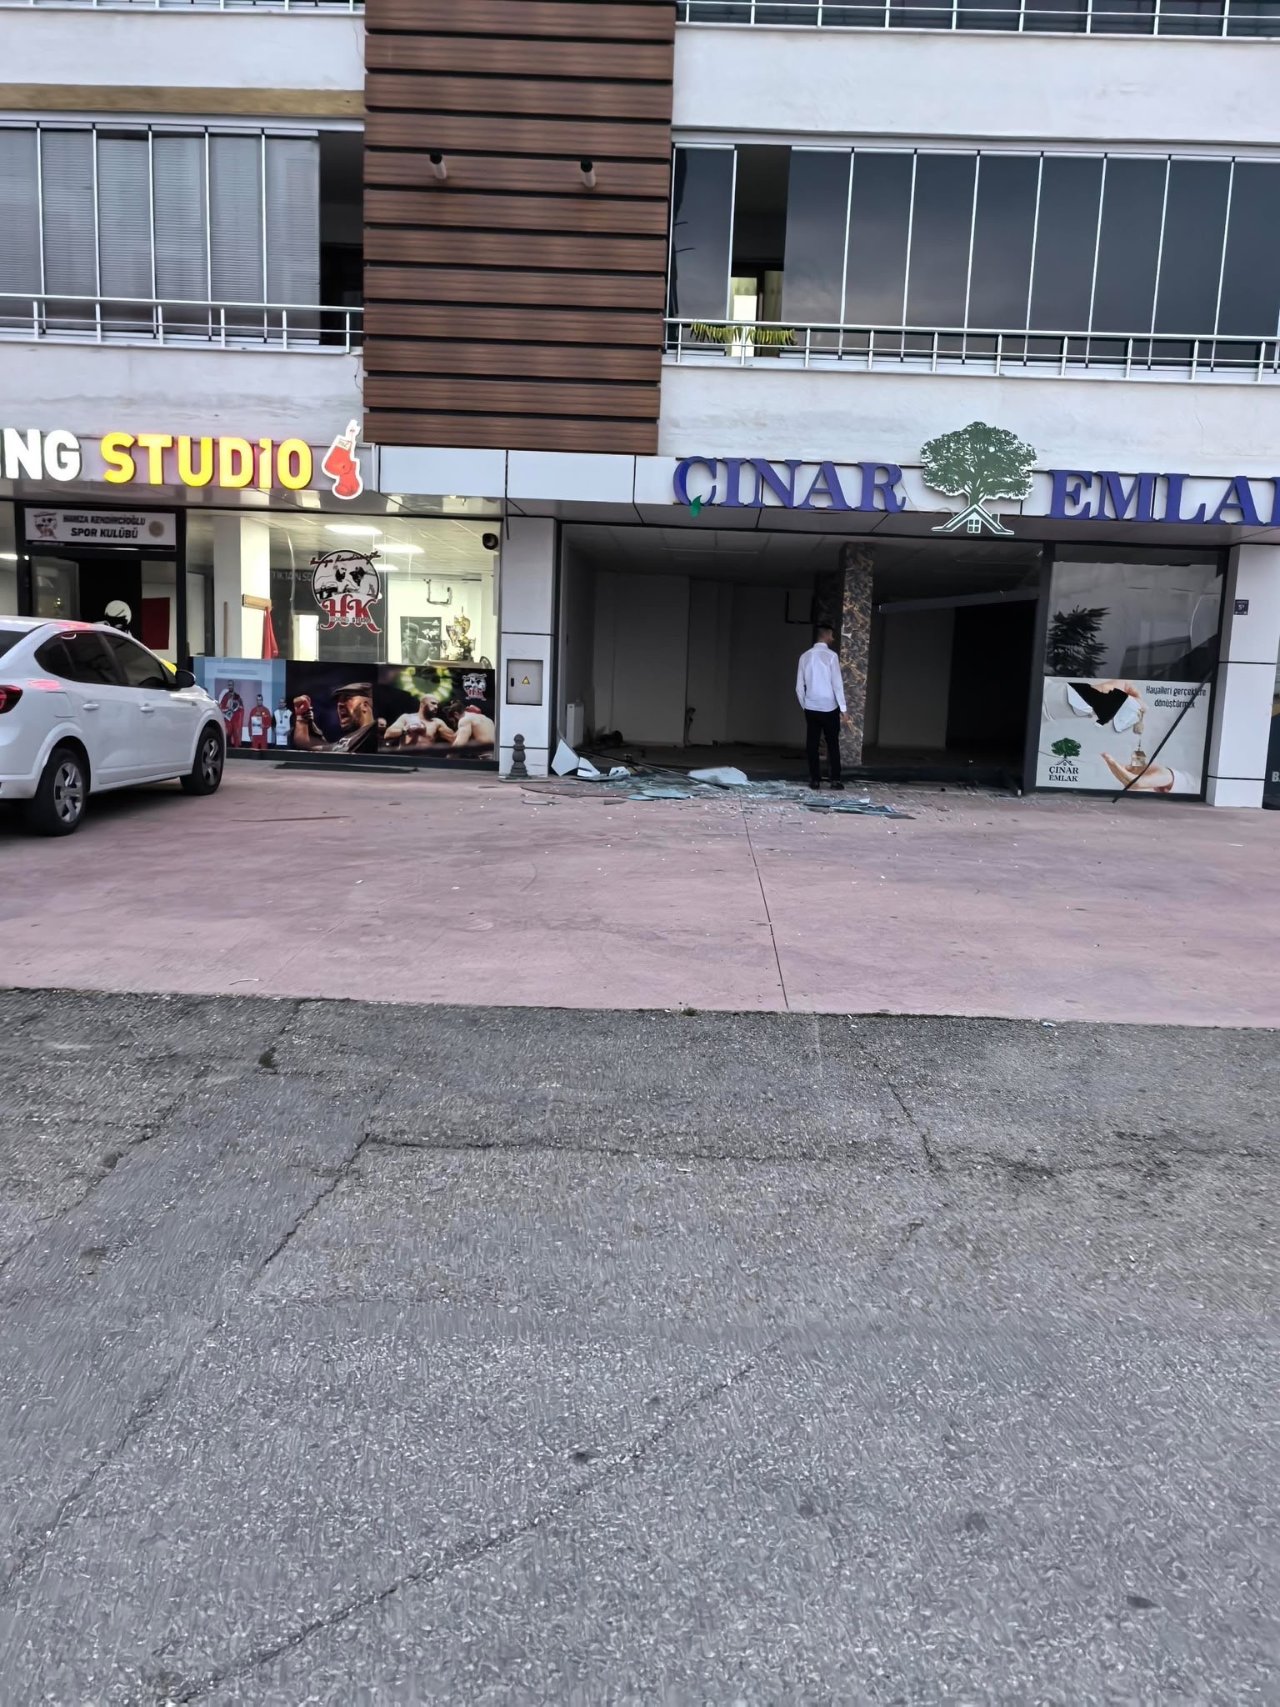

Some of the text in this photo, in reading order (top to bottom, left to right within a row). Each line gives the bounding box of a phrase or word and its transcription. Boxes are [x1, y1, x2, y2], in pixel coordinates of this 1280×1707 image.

[0, 428, 80, 482] NG
[1045, 469, 1280, 526] EMLA
[71, 527, 97, 537] SPOR
